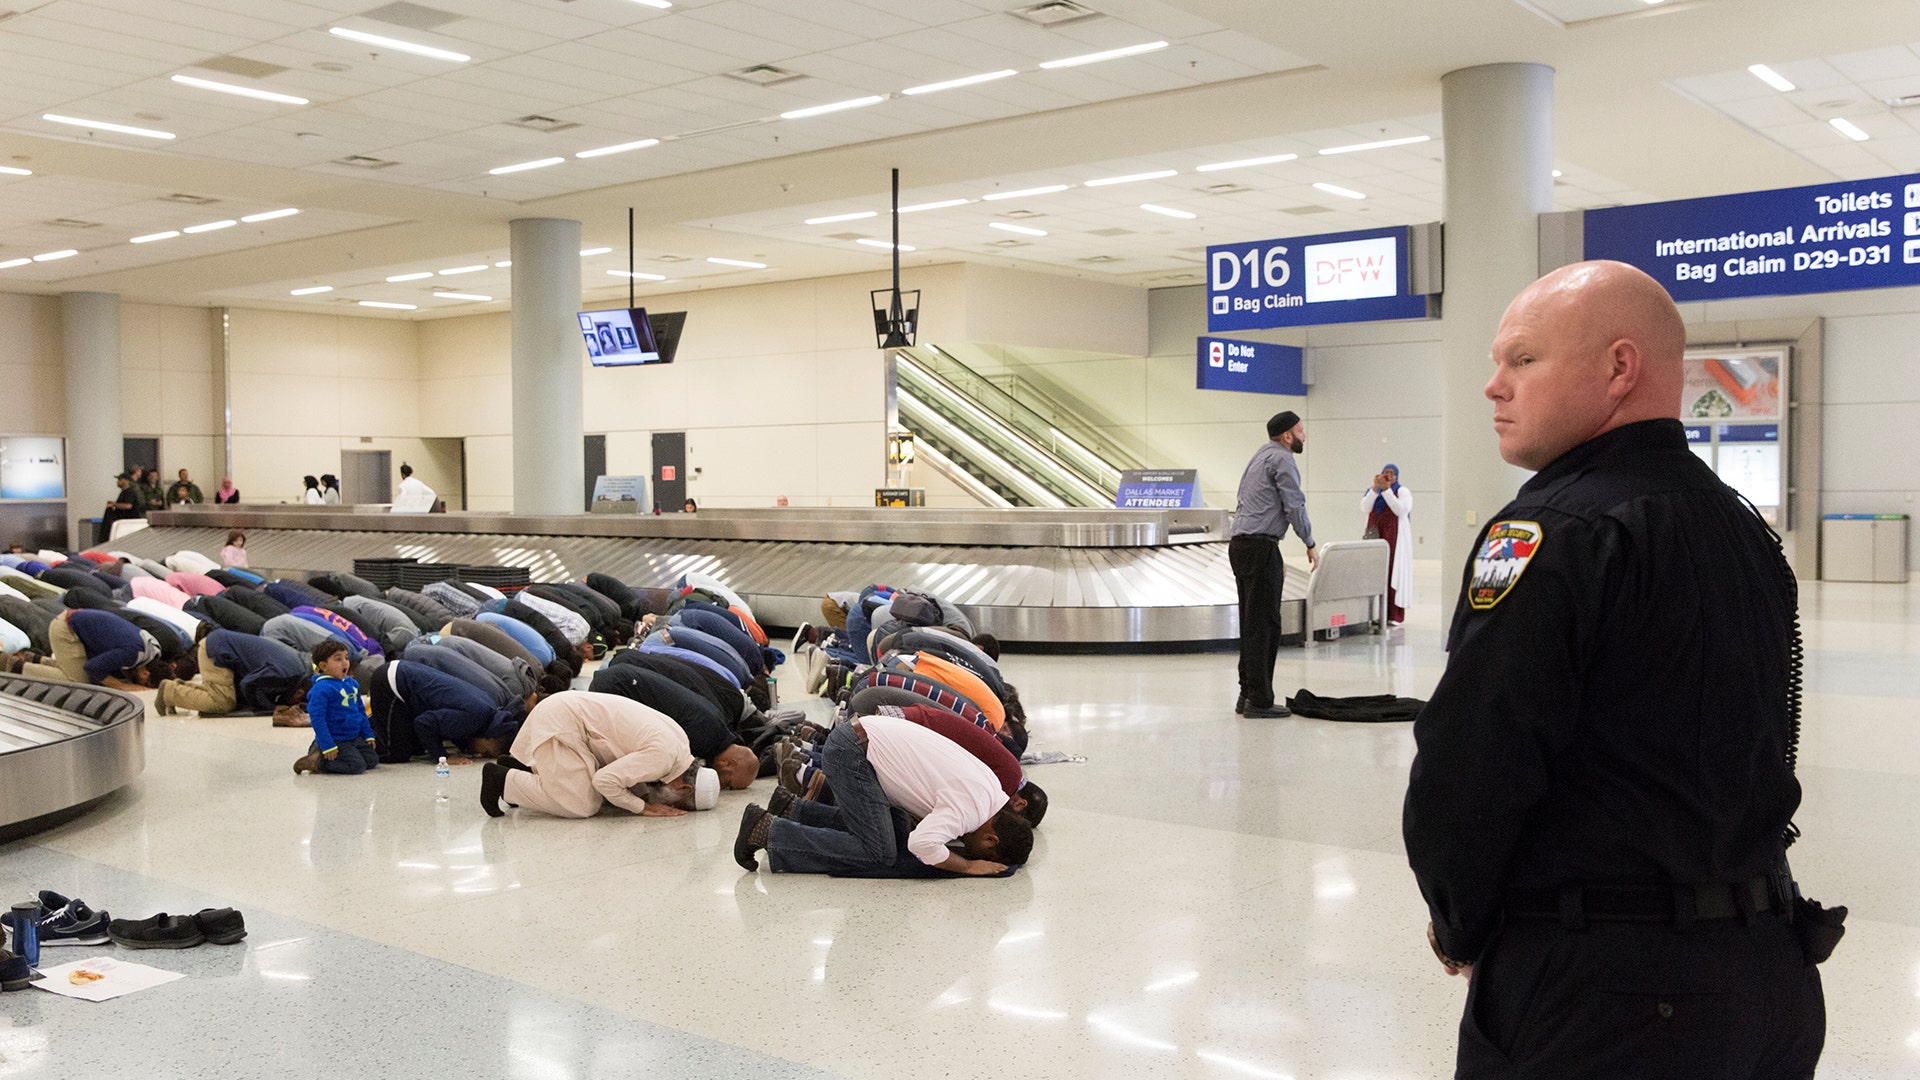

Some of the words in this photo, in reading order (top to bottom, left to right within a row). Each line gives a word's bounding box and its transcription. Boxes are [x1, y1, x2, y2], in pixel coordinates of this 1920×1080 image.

[1815, 190, 1892, 215] Toilets
[1656, 226, 1794, 256] International
[1801, 217, 1891, 244] Arrivals
[1212, 246, 1291, 292] D16
[1316, 255, 1385, 286] DFW
[1675, 263, 1717, 283] Bag
[1723, 254, 1786, 277] Claim
[1793, 244, 1891, 271] D29-D31
[1234, 298, 1261, 313] Bag
[1264, 294, 1304, 309] Claim
[1228, 344, 1239, 356] Do
[1240, 346, 1255, 358] Not
[1228, 360, 1249, 373] Enter
[1125, 499, 1181, 507] ATTENDEES
